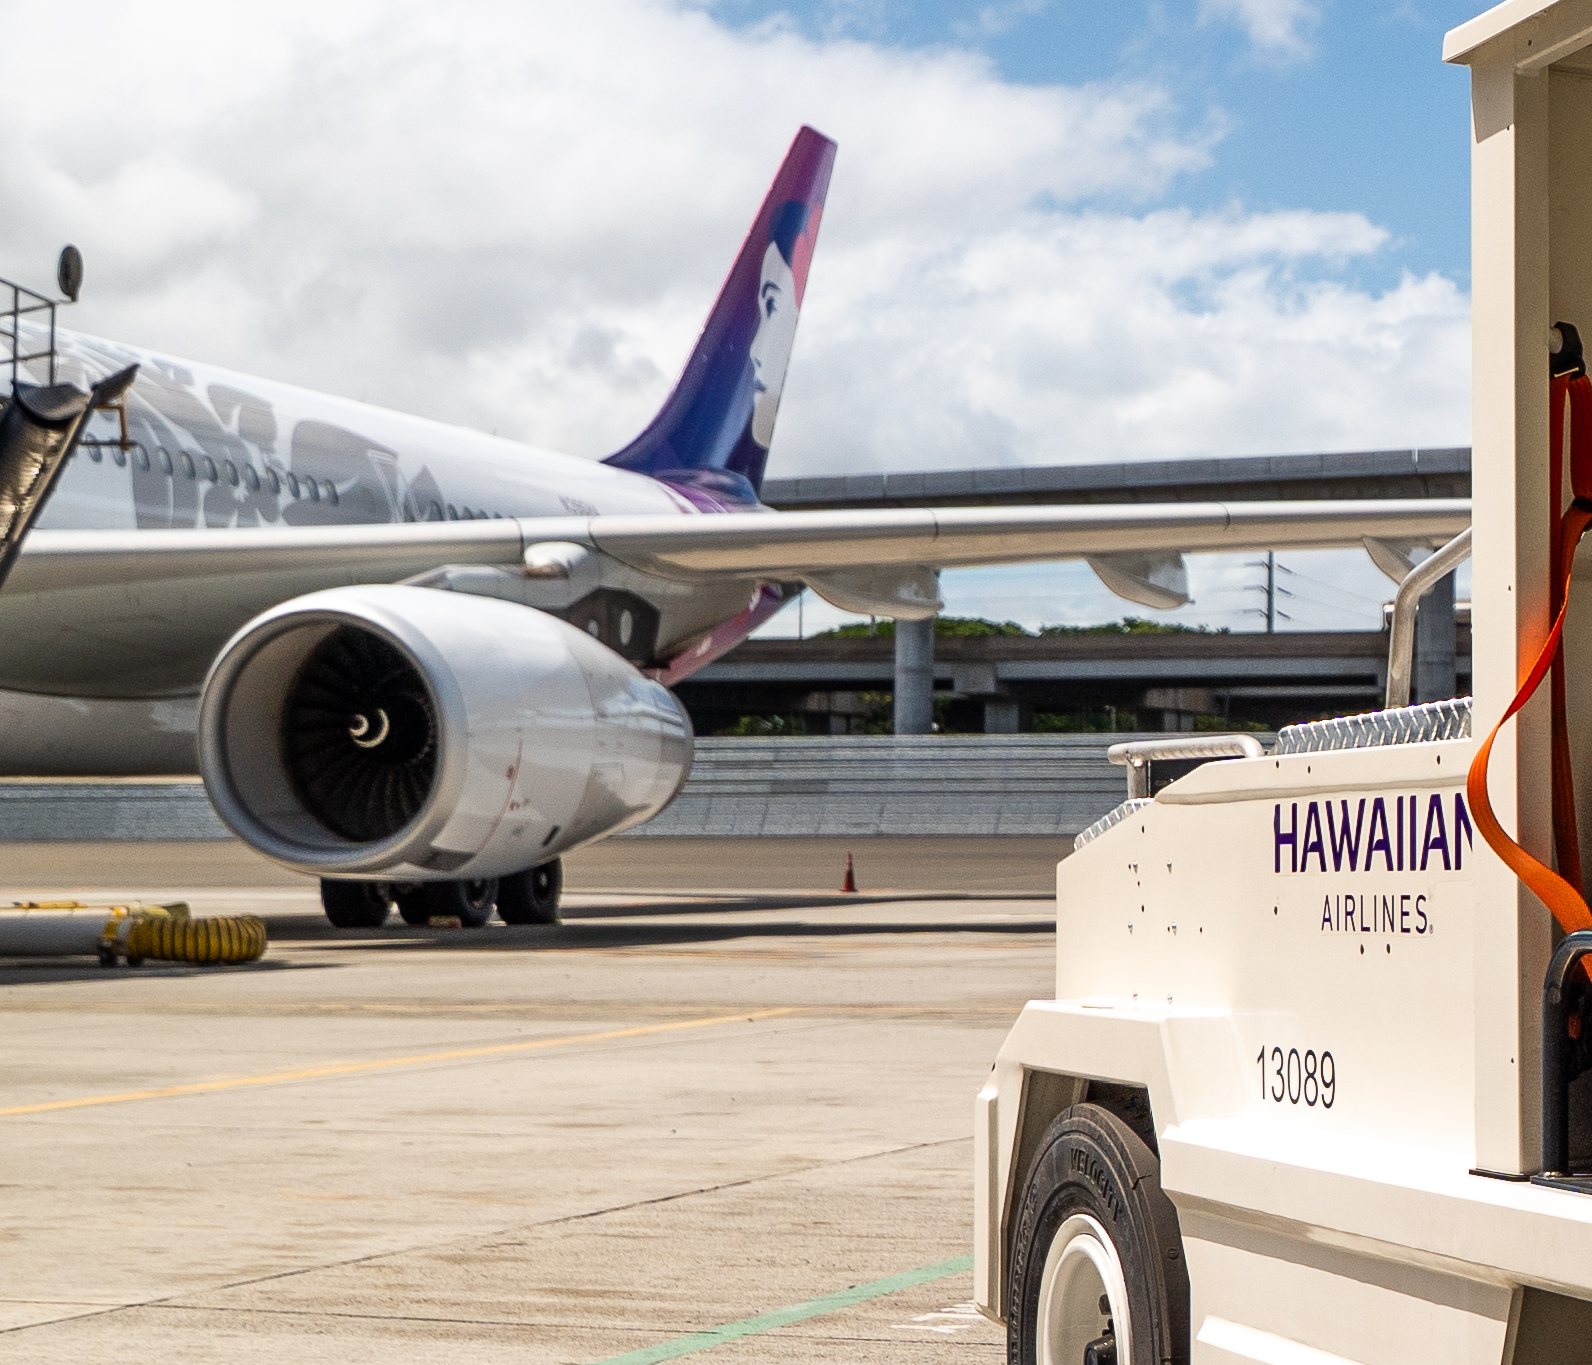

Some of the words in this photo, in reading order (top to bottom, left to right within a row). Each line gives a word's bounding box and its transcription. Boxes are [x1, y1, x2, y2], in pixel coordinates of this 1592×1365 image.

[1273, 792, 1473, 874] HAWAIIAN
[1320, 894, 1429, 935] AIRLINES
[1256, 1044, 1336, 1110] 13089
